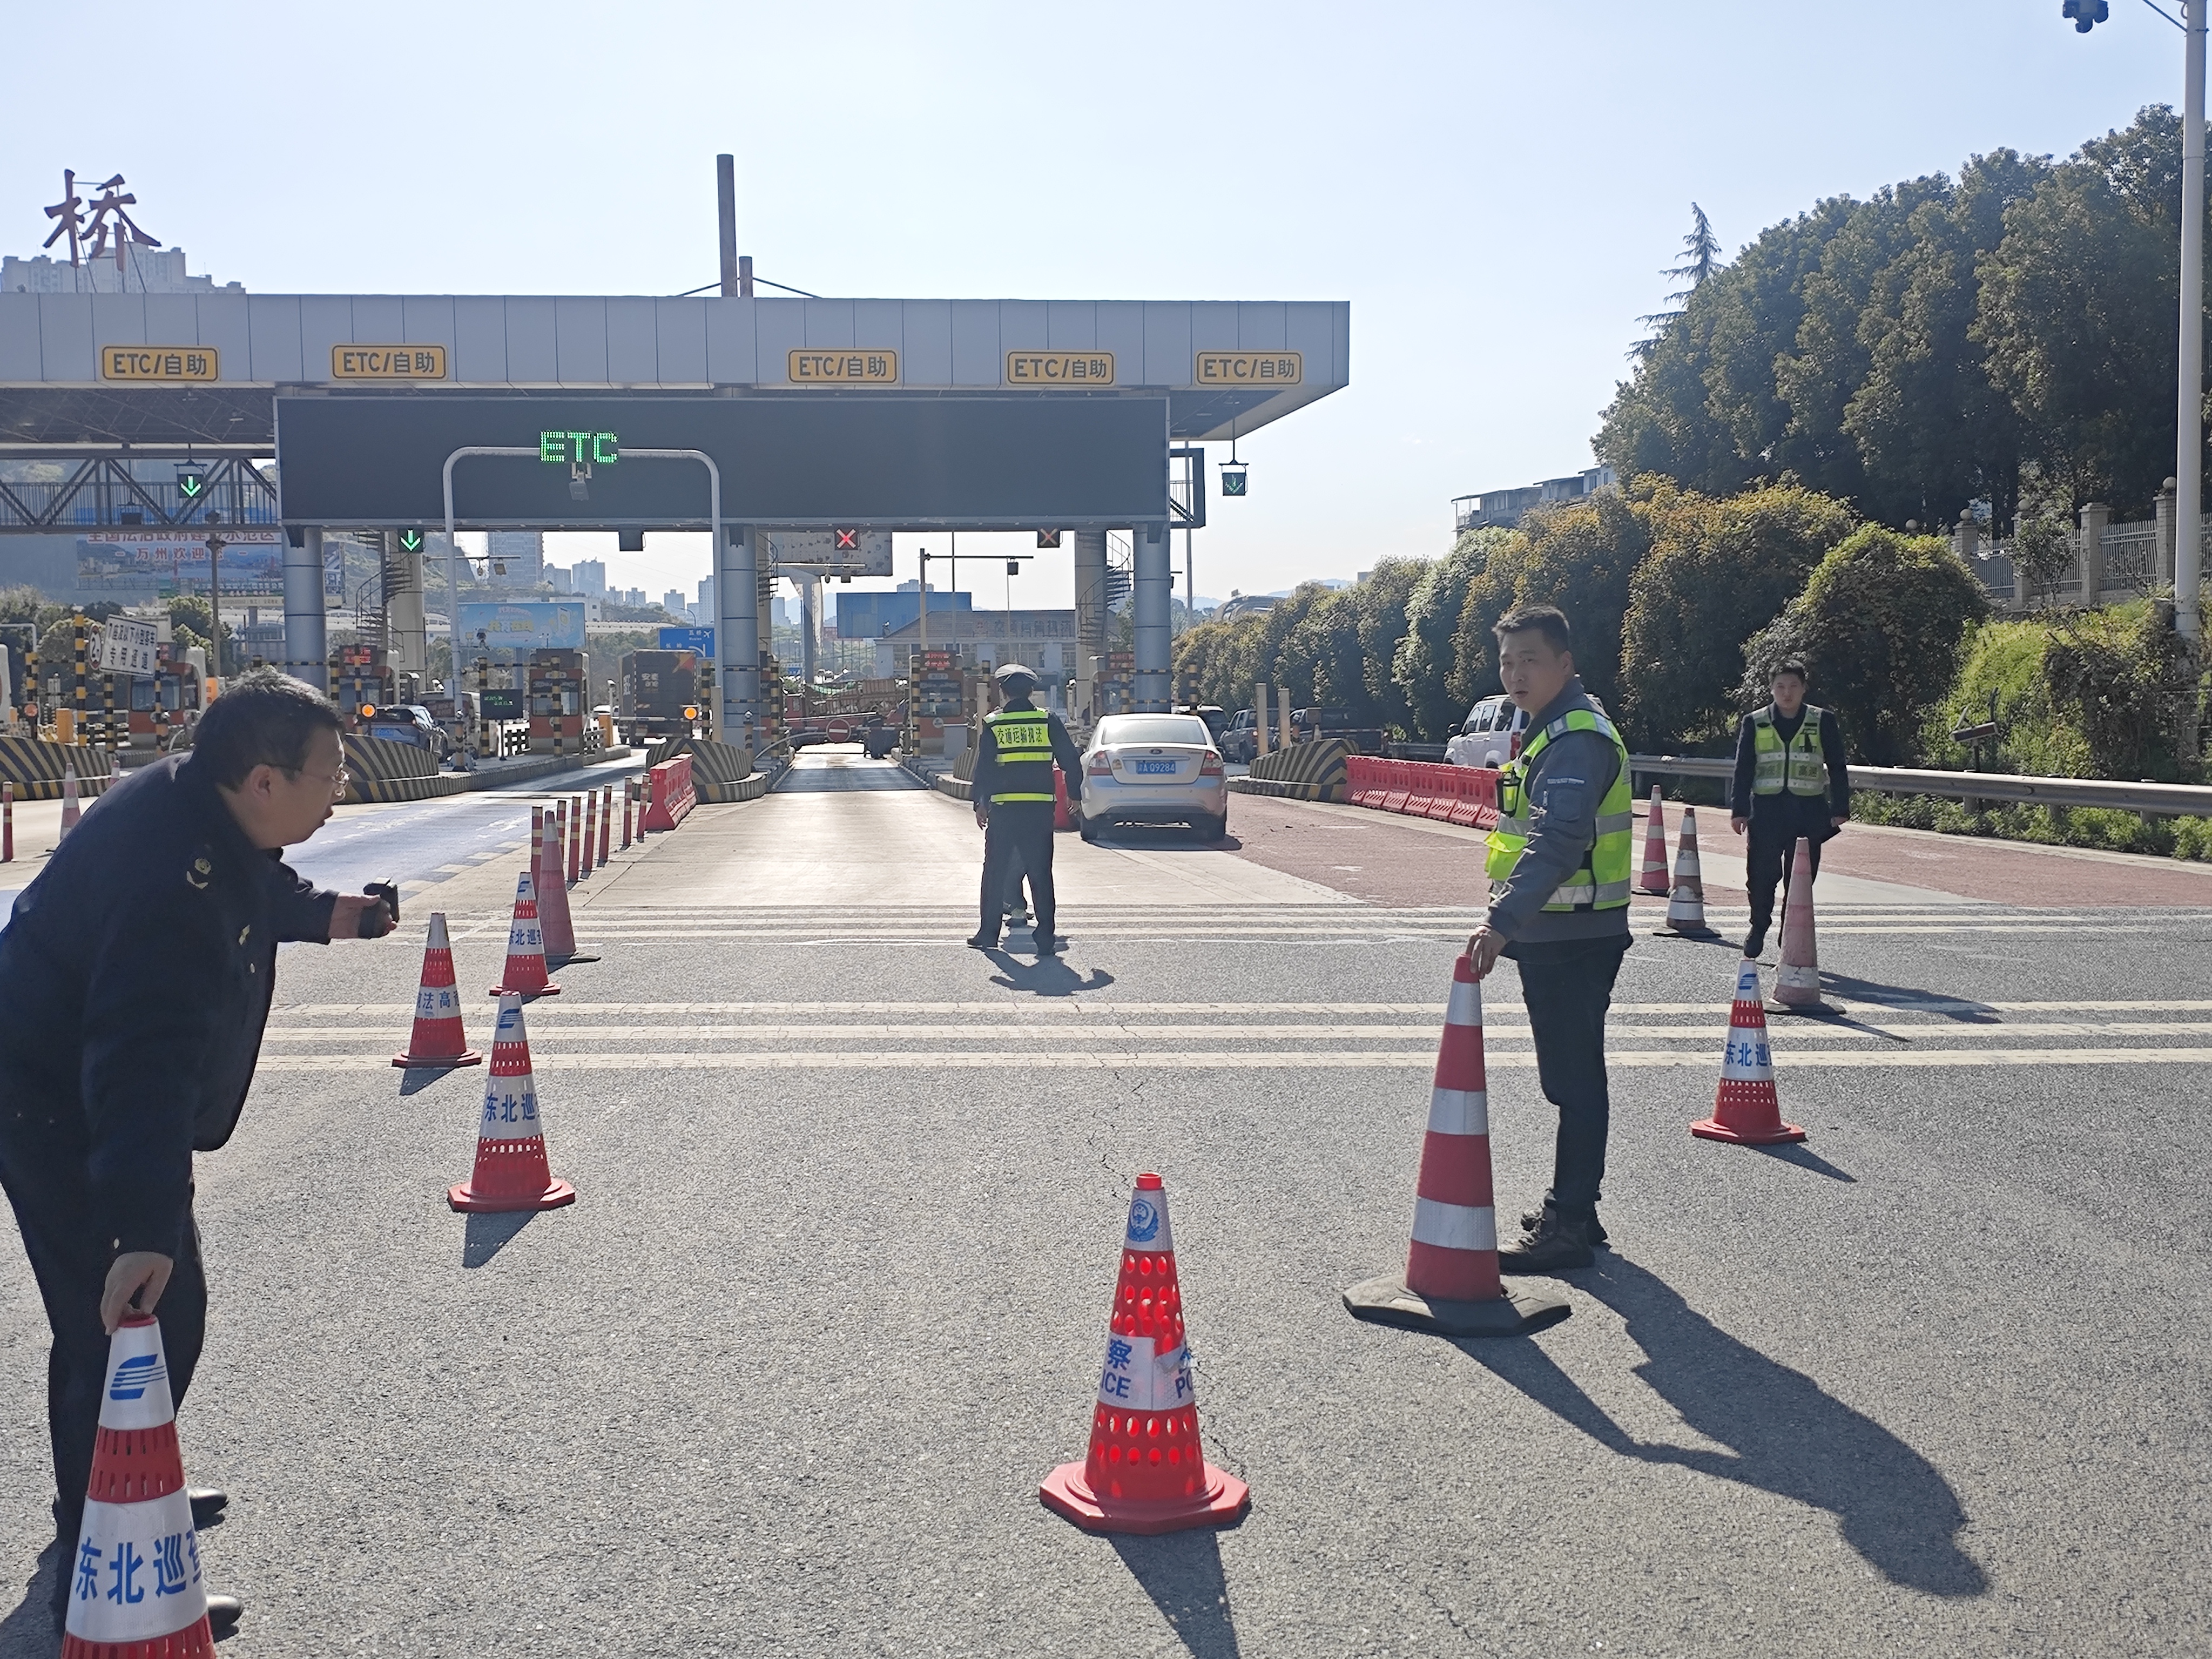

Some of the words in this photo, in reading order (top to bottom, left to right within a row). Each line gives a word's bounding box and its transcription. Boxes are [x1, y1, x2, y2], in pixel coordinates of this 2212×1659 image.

[42, 168, 162, 272] 桥
[113, 353, 207, 375] ETC/自助
[343, 352, 435, 373] ETC/自助
[799, 356, 887, 377] ETC/自助
[1015, 359, 1107, 378] ETC/自助
[1204, 359, 1294, 378] ETC/自助
[540, 430, 618, 463] ETC
[997, 726, 1042, 744] 交通运输执法
[1724, 1041, 1772, 1067] 东北巡
[485, 1092, 540, 1123] 东北巡
[1108, 1338, 1132, 1371] 察
